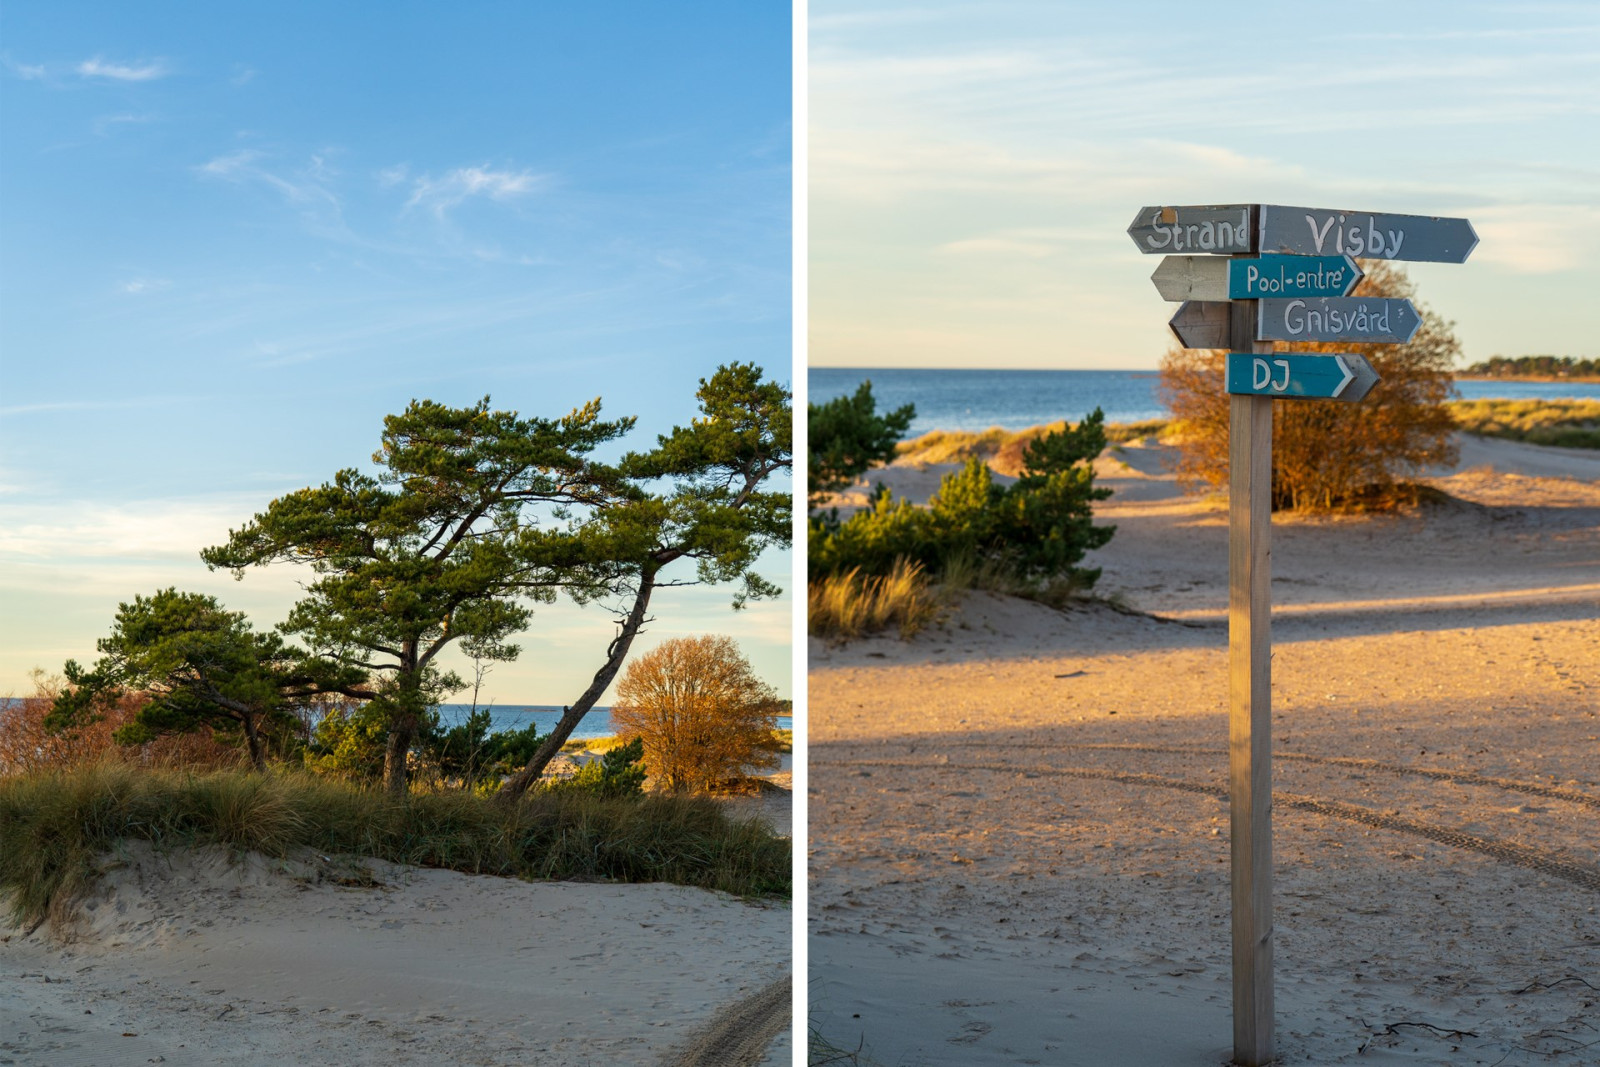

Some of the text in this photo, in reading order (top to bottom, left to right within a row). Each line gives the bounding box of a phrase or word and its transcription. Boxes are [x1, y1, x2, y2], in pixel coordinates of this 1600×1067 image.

[1146, 208, 1248, 250] Strand
[1305, 214, 1404, 259] Visby
[1284, 299, 1392, 335] Gnisvärd
[1252, 358, 1290, 392] DJ
